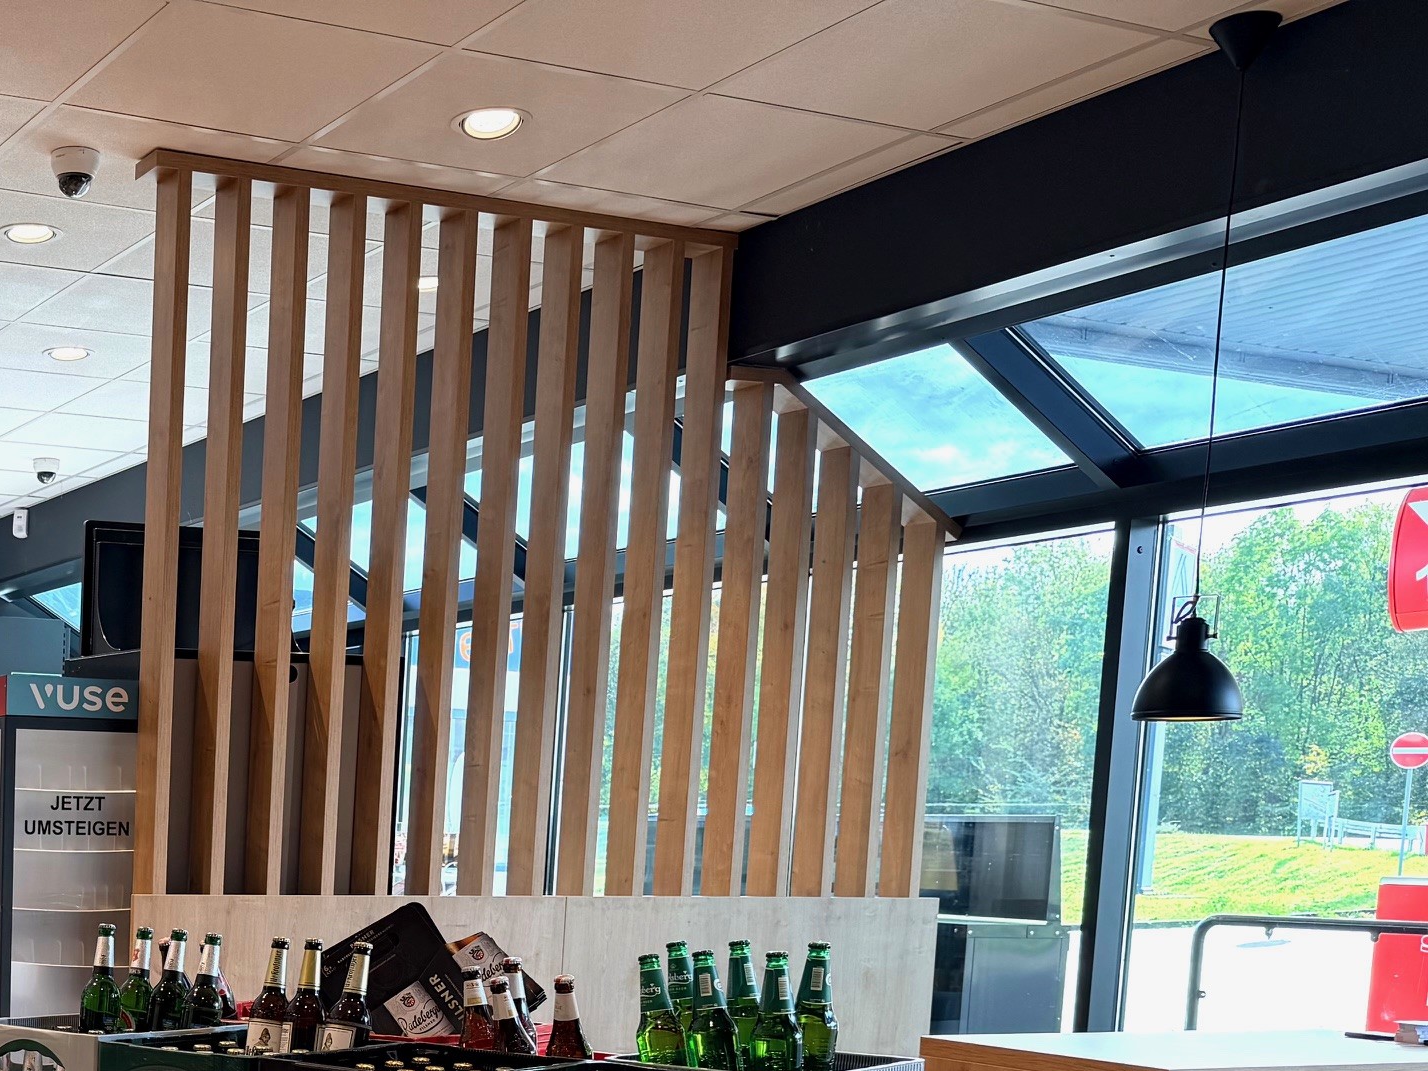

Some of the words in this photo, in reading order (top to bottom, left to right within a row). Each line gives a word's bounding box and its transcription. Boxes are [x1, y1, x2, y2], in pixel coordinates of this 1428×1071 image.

[50, 796, 105, 811] JETZT
[24, 820, 130, 837] UMSTEIGEN
[428, 973, 465, 1021] ILSNER
